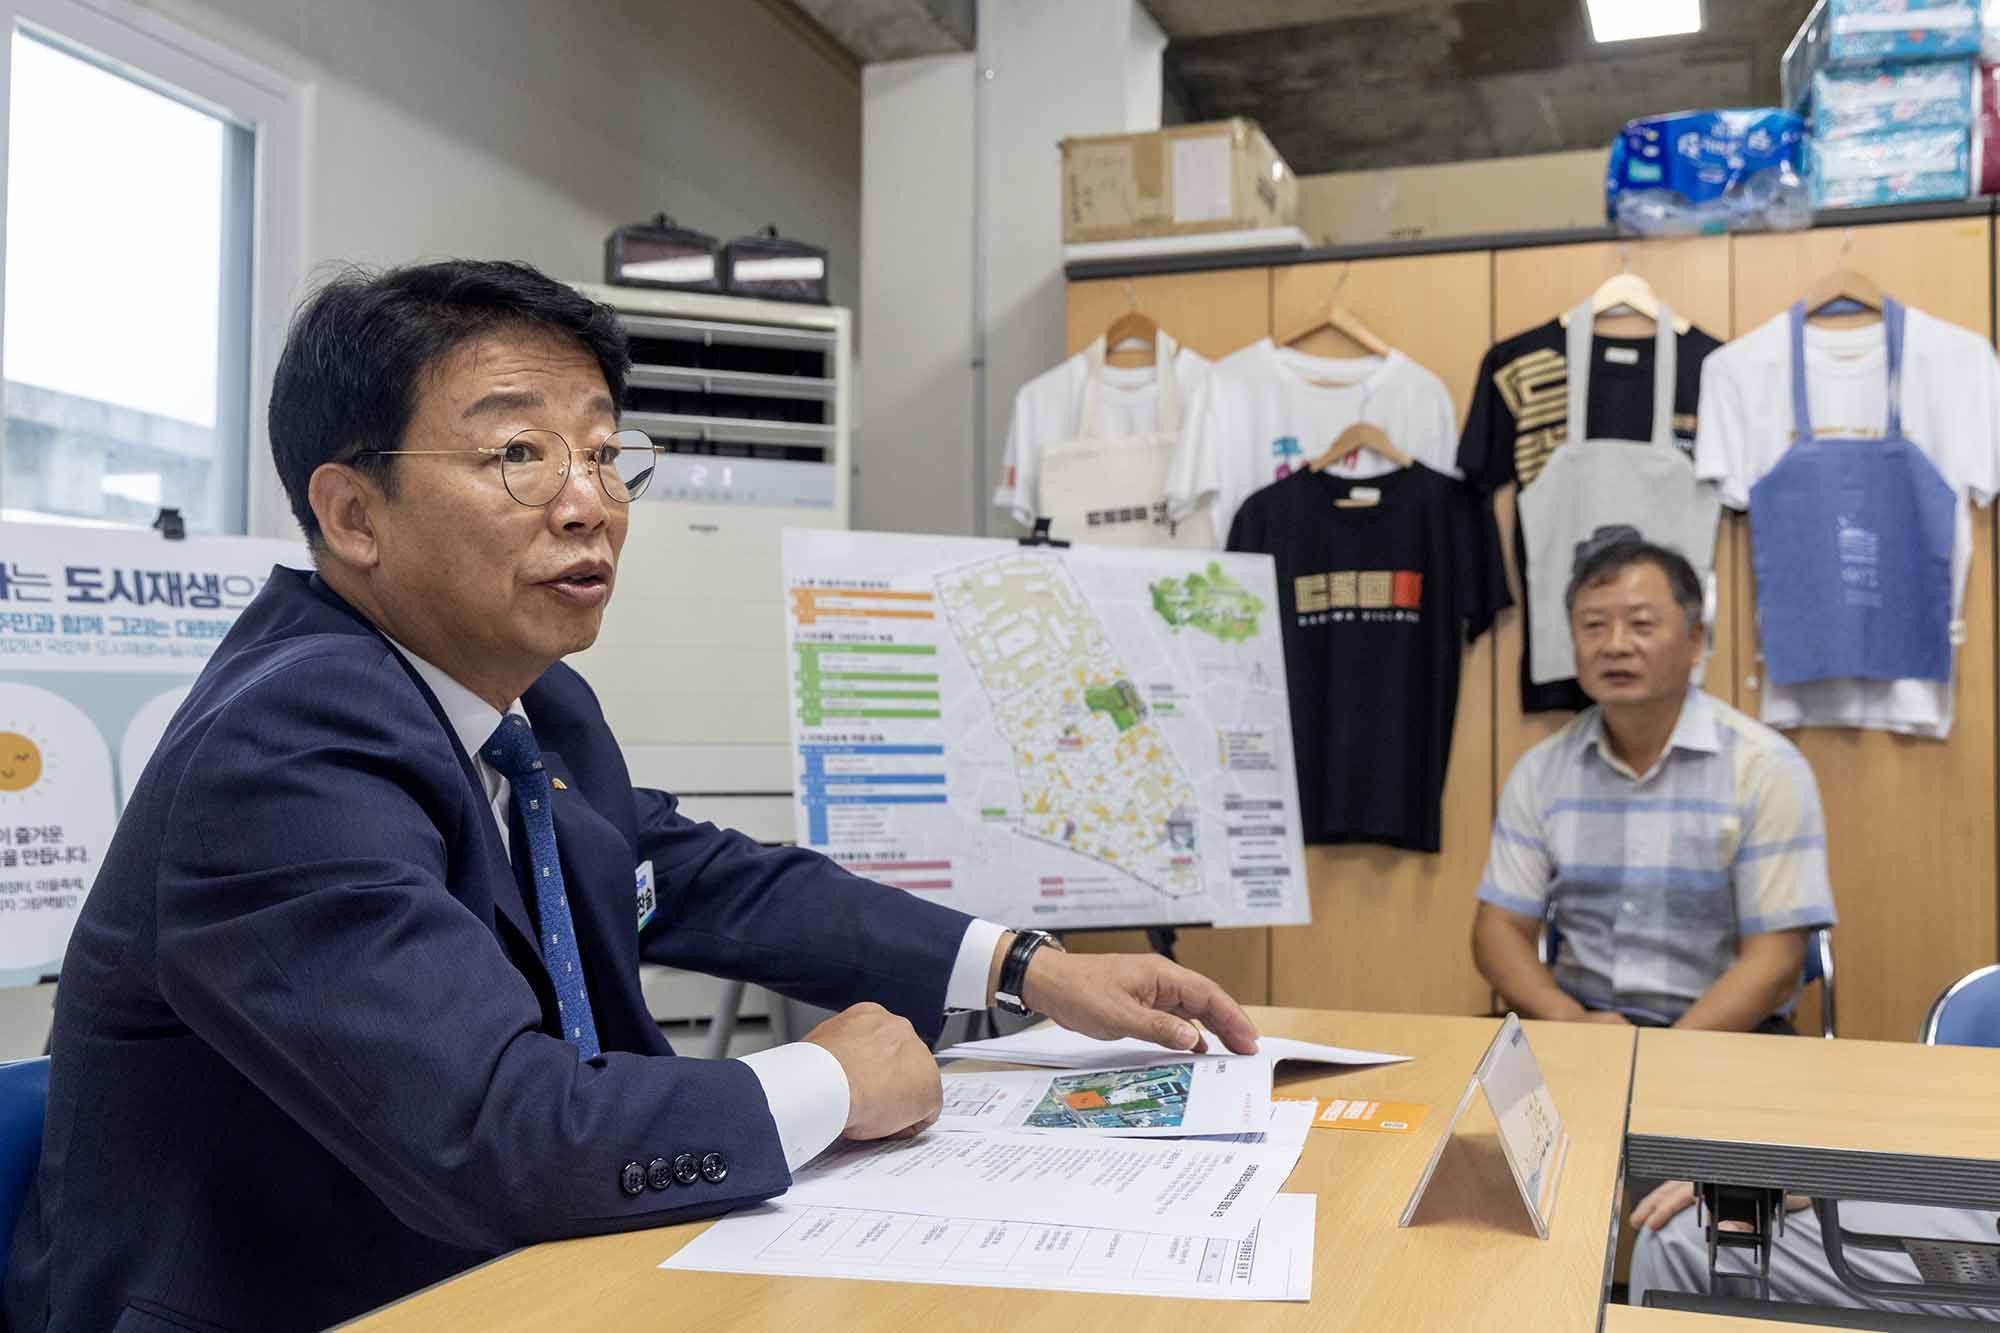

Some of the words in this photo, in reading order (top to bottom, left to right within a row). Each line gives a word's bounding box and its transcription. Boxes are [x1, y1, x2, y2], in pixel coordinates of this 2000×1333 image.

[65, 566, 268, 610] 도시재생으
[16, 825, 63, 845] 즐거운
[0, 849, 17, 868] 을
